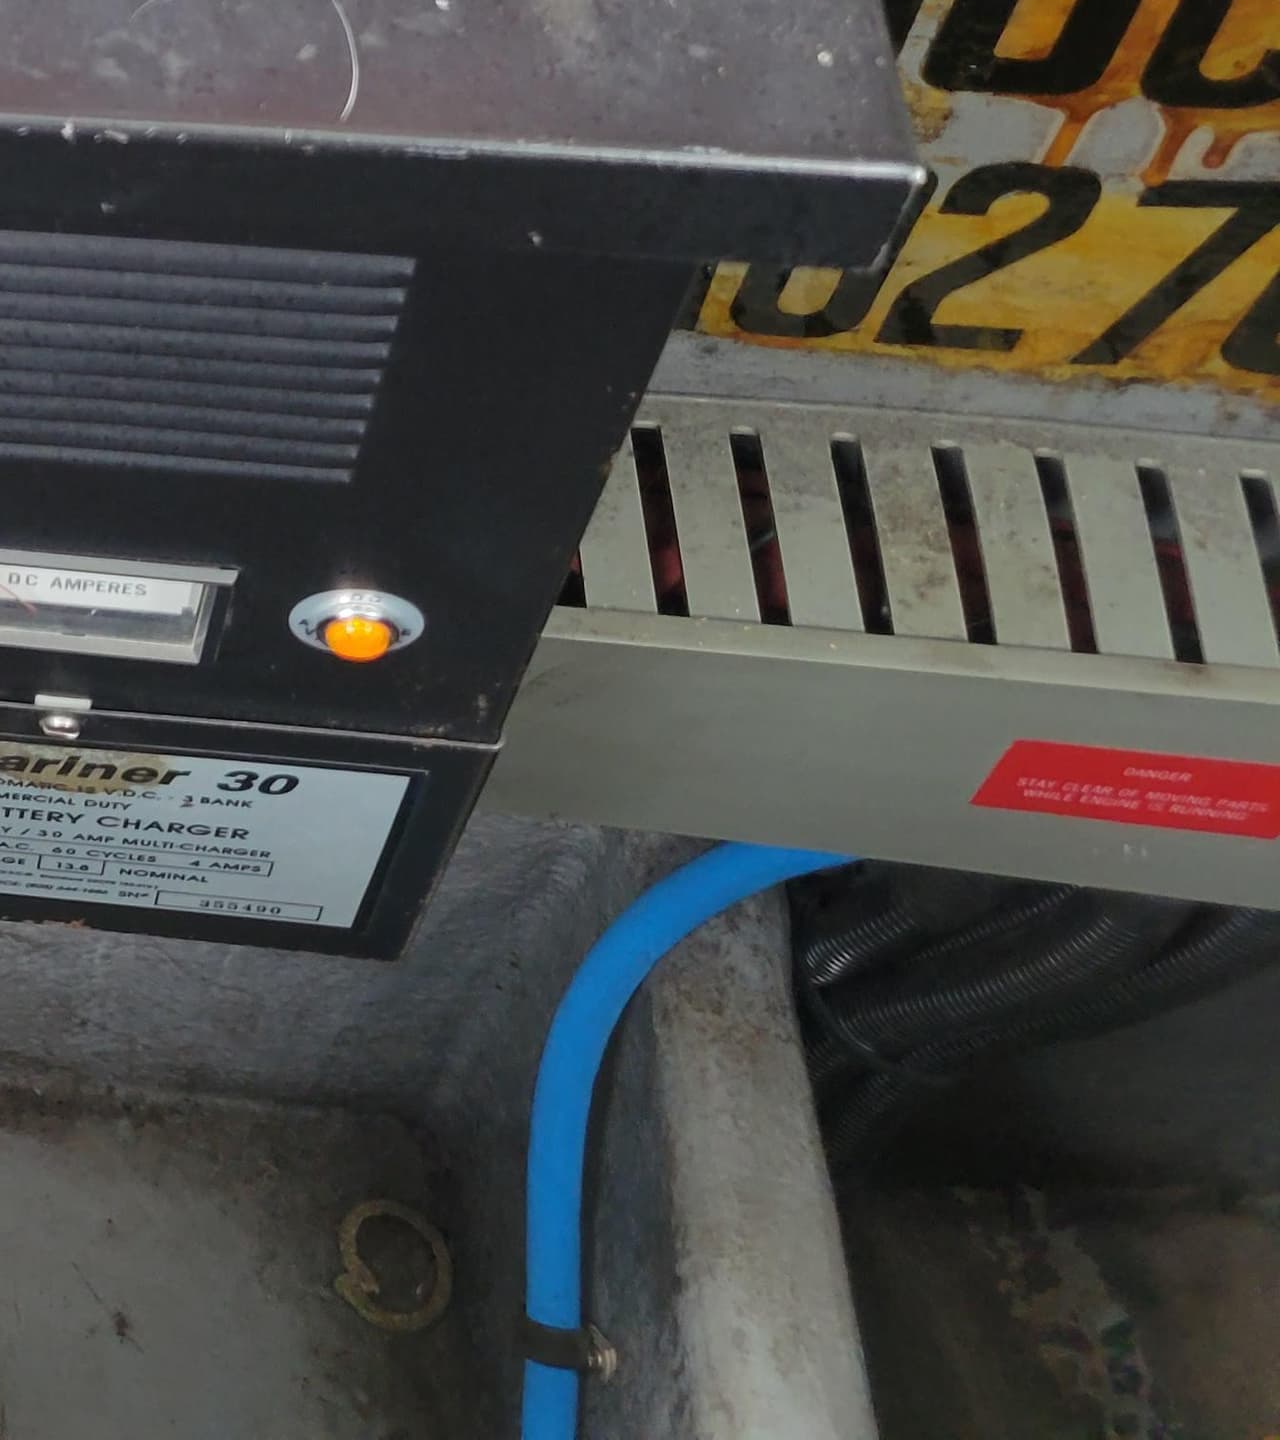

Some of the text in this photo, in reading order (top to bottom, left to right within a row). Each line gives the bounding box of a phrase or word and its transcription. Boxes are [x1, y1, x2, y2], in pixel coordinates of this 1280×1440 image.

[49, 575, 148, 597] AMPERES
[216, 769, 300, 796] 30
[1123, 766, 1192, 783] DANGER
[200, 796, 253, 810] BANK
[1016, 776, 1057, 790] STAY
[1061, 781, 1114, 796] CLEAR
[1118, 786, 1140, 798] OF
[1145, 790, 1212, 808] MOVING
[84, 799, 133, 811] DUTY
[1023, 788, 1073, 803] WHILE
[1079, 794, 1141, 811] ENGINE
[1169, 803, 1249, 822] RUNNING
[97, 816, 250, 840] CHARGER
[73, 833, 115, 844] AMP
[122, 837, 271, 859] MULTI-CHARGER
[86, 849, 156, 863] CYCLES
[209, 861, 261, 873] AMPS
[119, 867, 209, 884] NOMINAL
